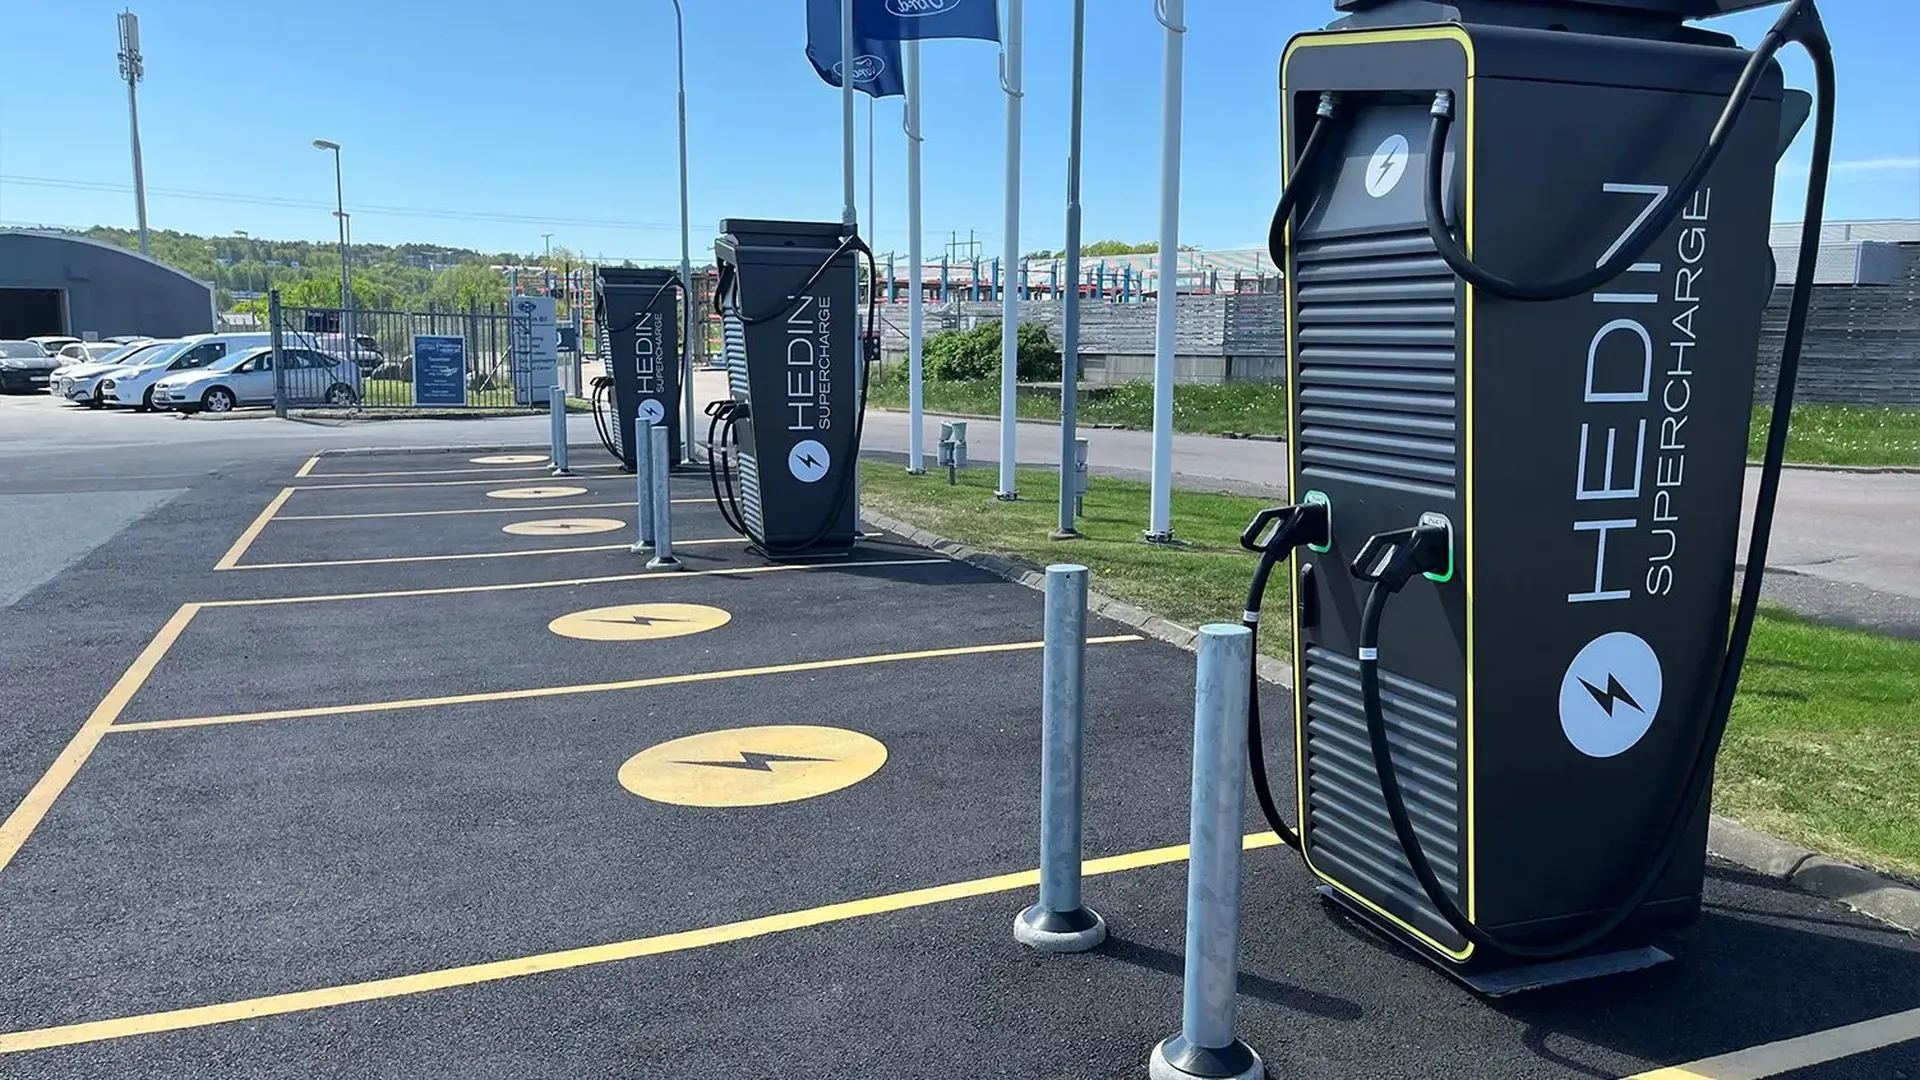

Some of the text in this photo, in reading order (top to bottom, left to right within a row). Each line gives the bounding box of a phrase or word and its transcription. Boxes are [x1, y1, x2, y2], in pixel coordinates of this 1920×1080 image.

[636, 312, 654, 394] HEDIN
[655, 313, 665, 393] SUPERCHARGE
[787, 295, 814, 430] HEDIN
[818, 296, 831, 430] SUPERCHARGE
[1568, 182, 1669, 602] HEDIN
[1646, 187, 1711, 596] SUPERCHARGE
